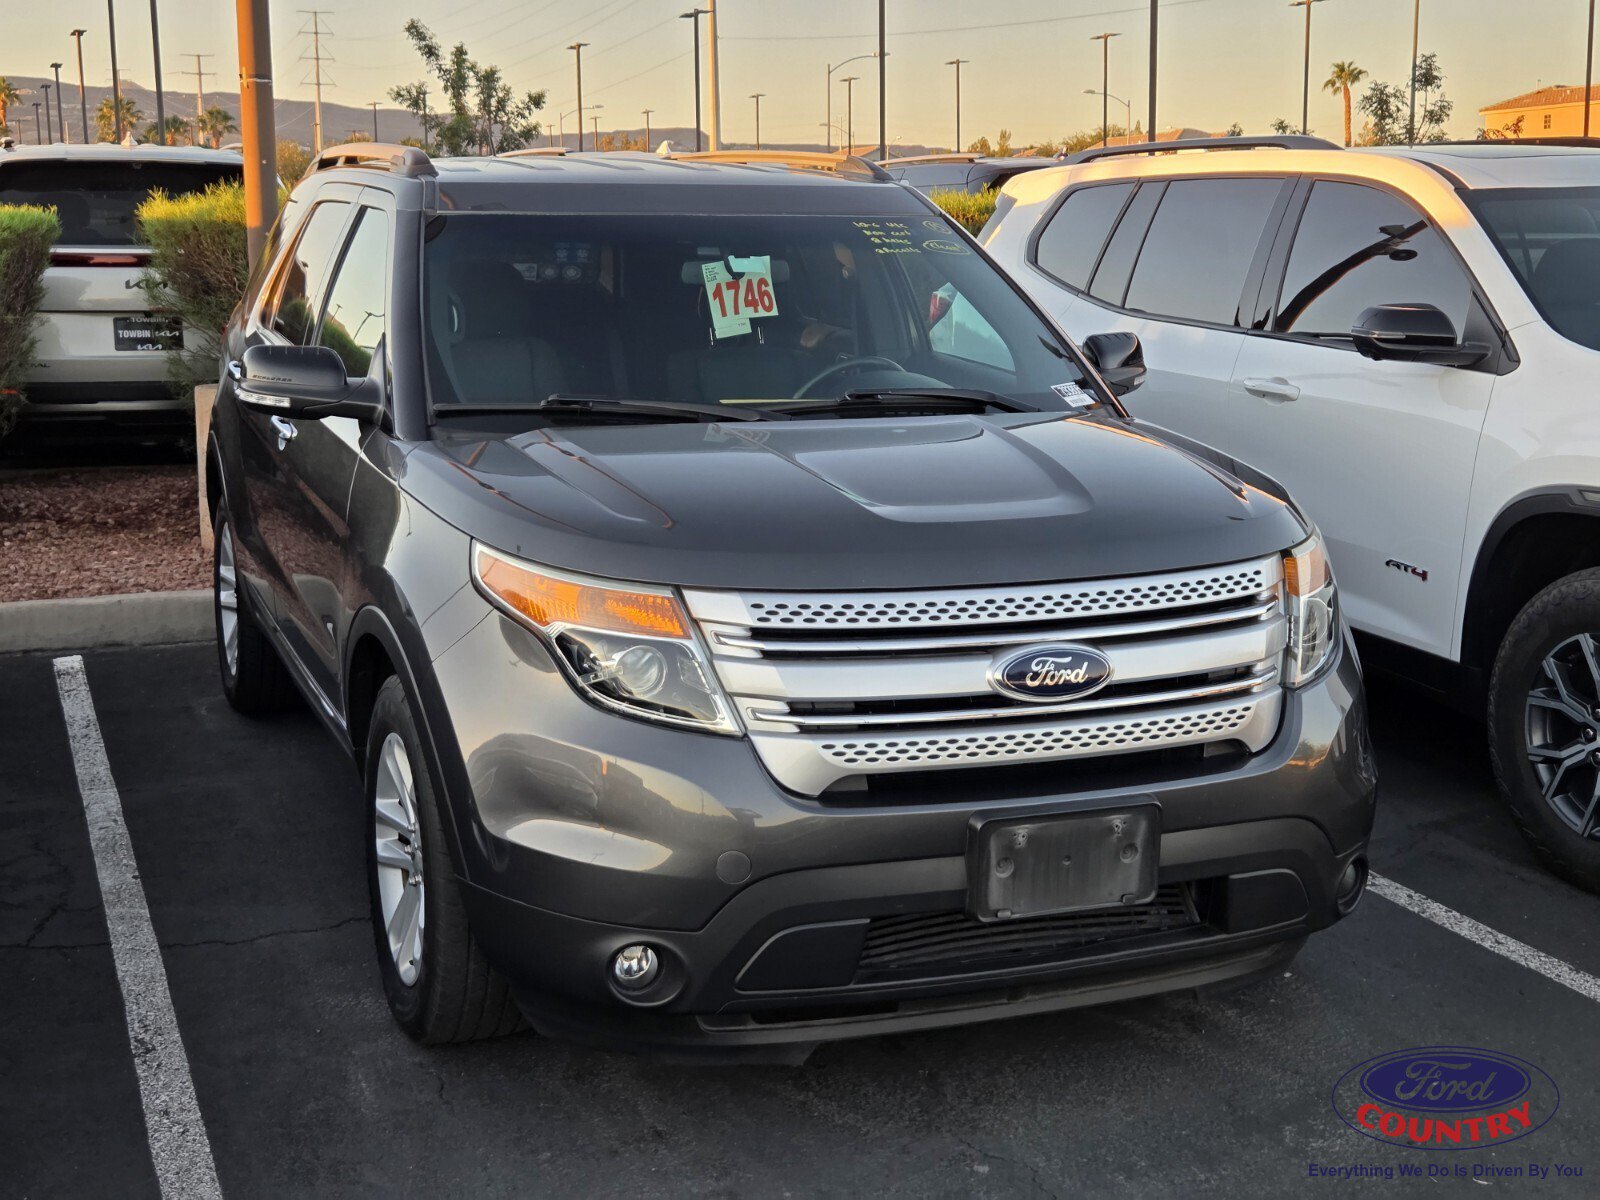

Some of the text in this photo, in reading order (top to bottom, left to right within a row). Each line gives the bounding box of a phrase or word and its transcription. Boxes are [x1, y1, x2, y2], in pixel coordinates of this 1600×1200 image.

[712, 277, 774, 318] 1746
[117, 329, 151, 338] TOWBIN
[1385, 558, 1429, 582] AT4
[1025, 656, 1089, 688] Ford
